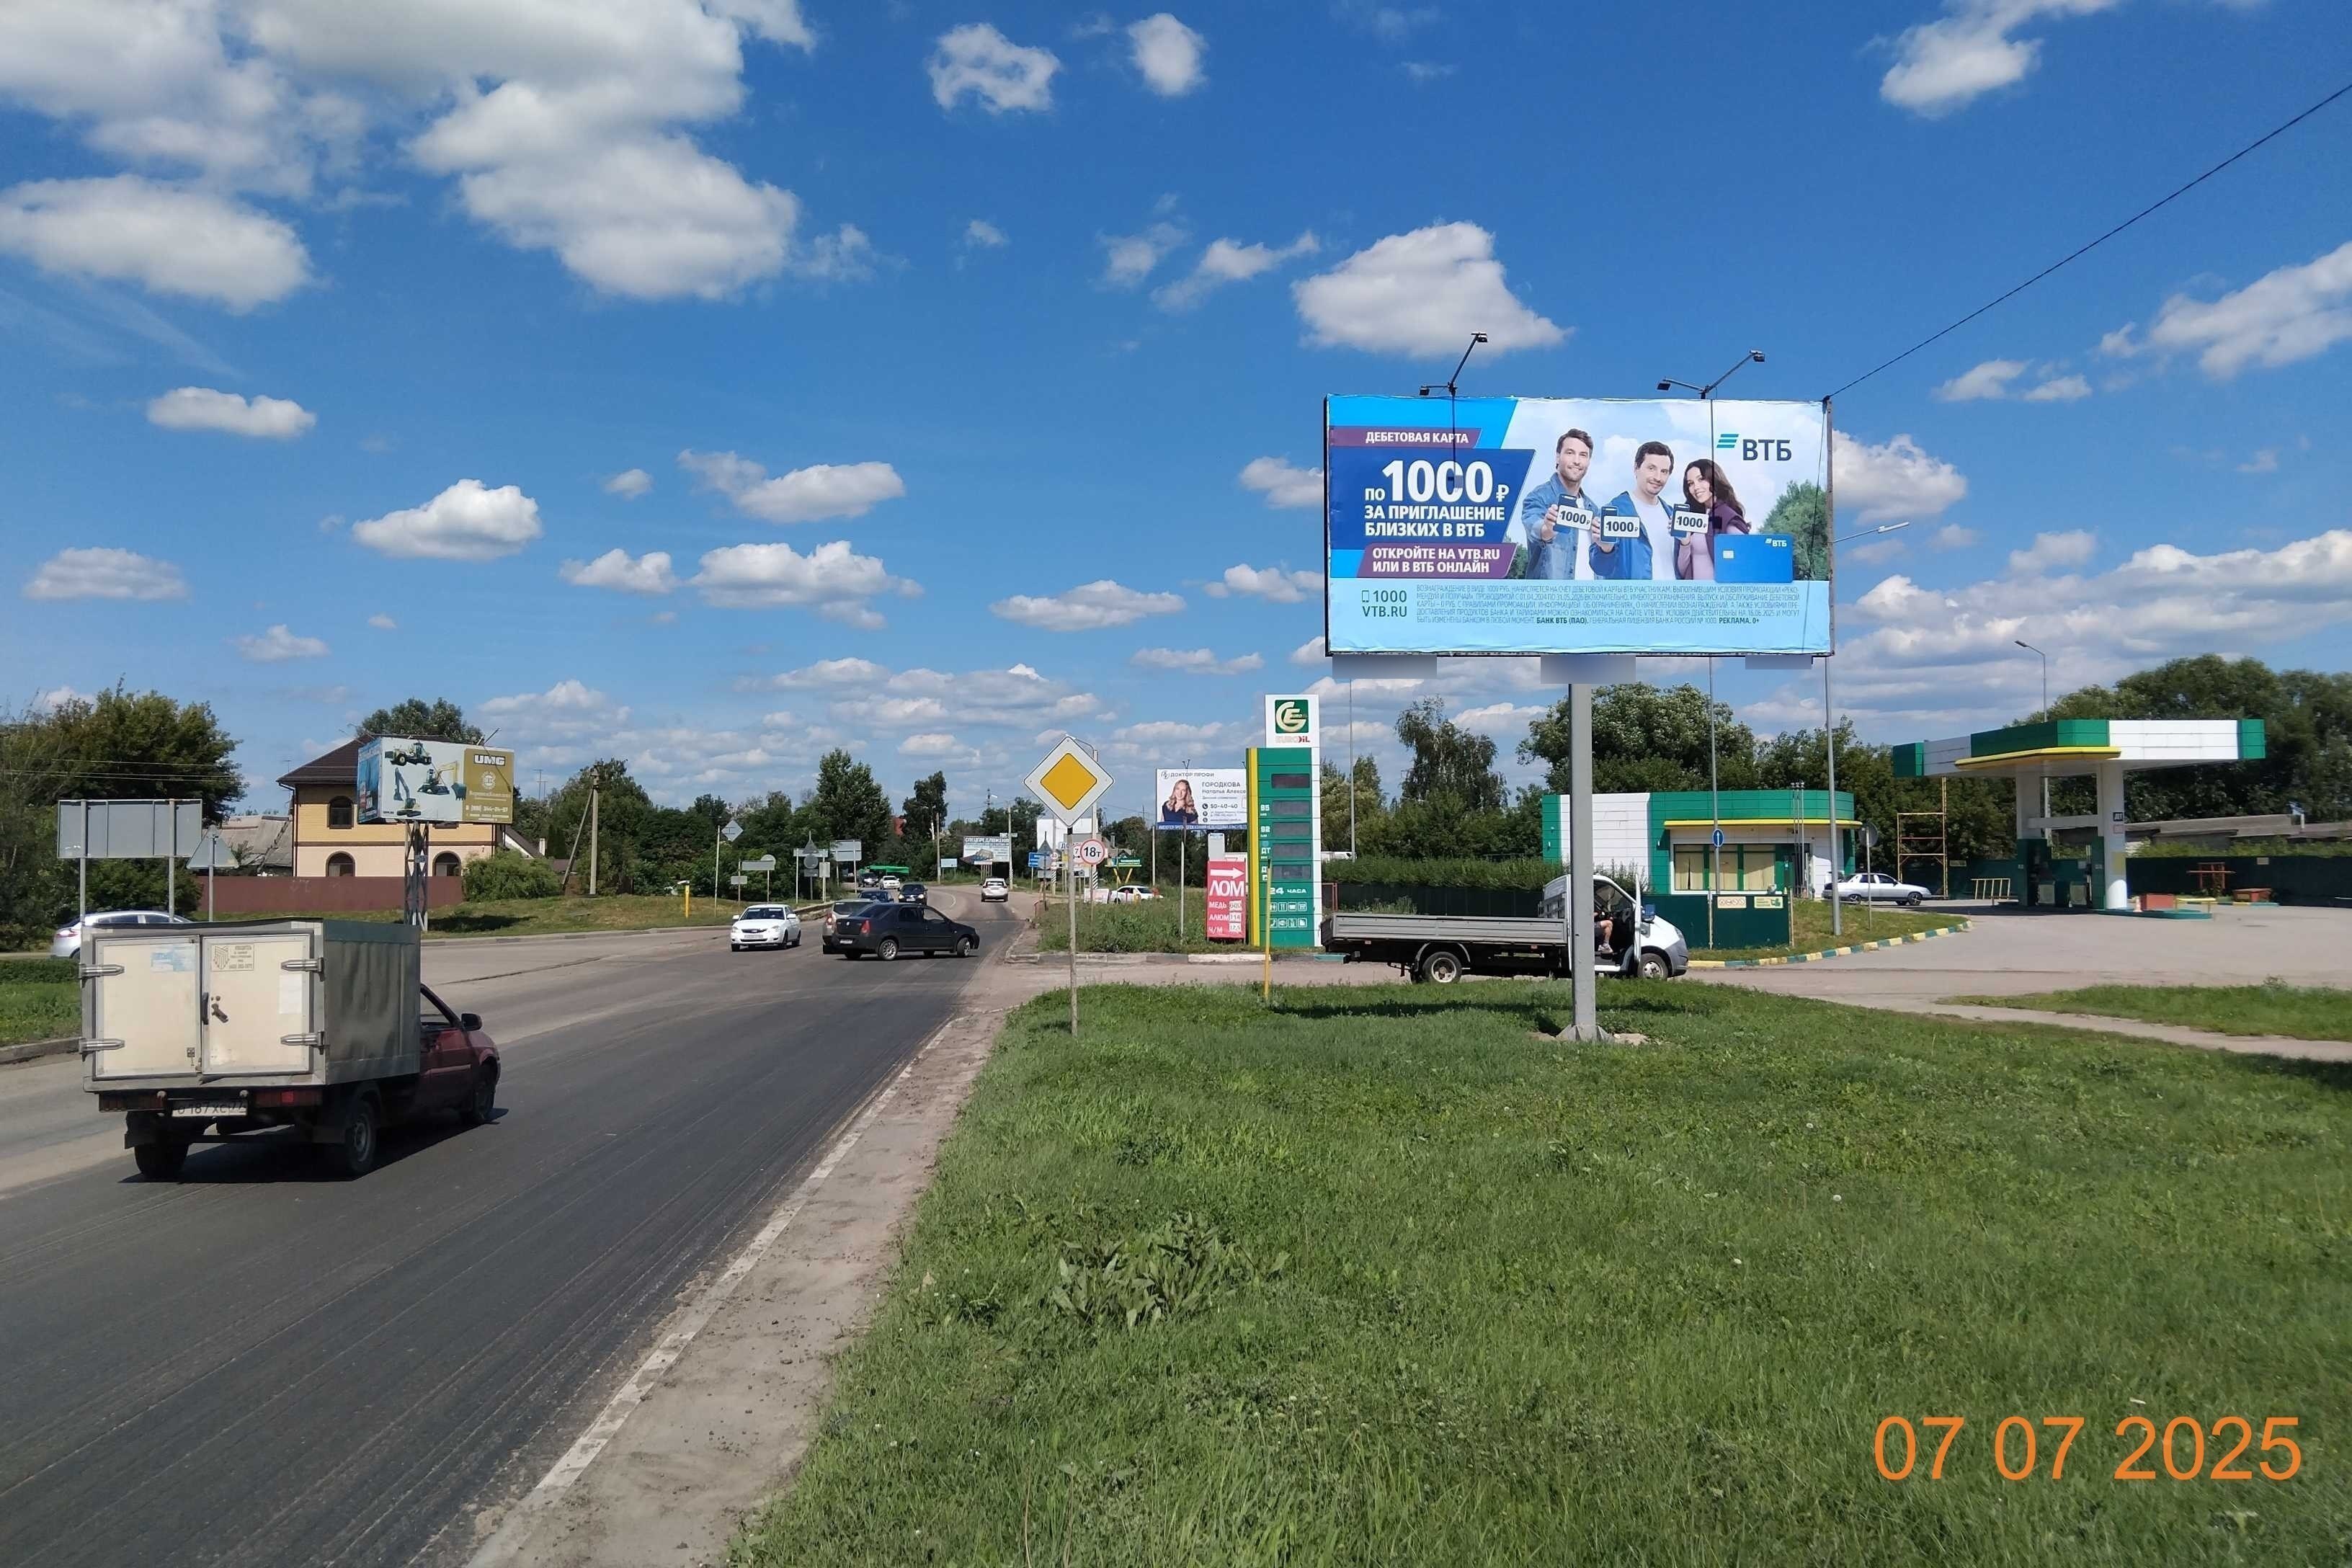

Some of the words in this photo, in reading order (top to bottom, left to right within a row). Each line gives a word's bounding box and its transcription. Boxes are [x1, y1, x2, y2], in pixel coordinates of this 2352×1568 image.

[1366, 432, 1430, 444] ДЕБЕТОВАЯ
[1433, 432, 1469, 444] КАРТА
[1742, 439, 1792, 461] ВТБ
[1382, 460, 1493, 503] 1000
[1364, 505, 1385, 520] ЗА
[1389, 505, 1505, 520] ПРИГЛАШЕНИЕ
[1366, 522, 1440, 537] БЛИЗКИХ
[1443, 523, 1453, 537] В
[1456, 523, 1485, 537] ВТБ
[1372, 545, 1436, 559] ОТКРОЙТЕ
[1438, 548, 1456, 559] НА
[1458, 548, 1500, 560] VTB.RU
[1373, 561, 1399, 572] ИЛИ
[1402, 561, 1409, 572] В
[1412, 561, 1435, 572] ВТБ
[1437, 560, 1489, 573] ОНЛАЙН
[1373, 589, 1407, 603] 1000
[1362, 605, 1407, 618] VTB.RU
[474, 754, 505, 765] UMG
[1209, 880, 1245, 897] ЛОМ
